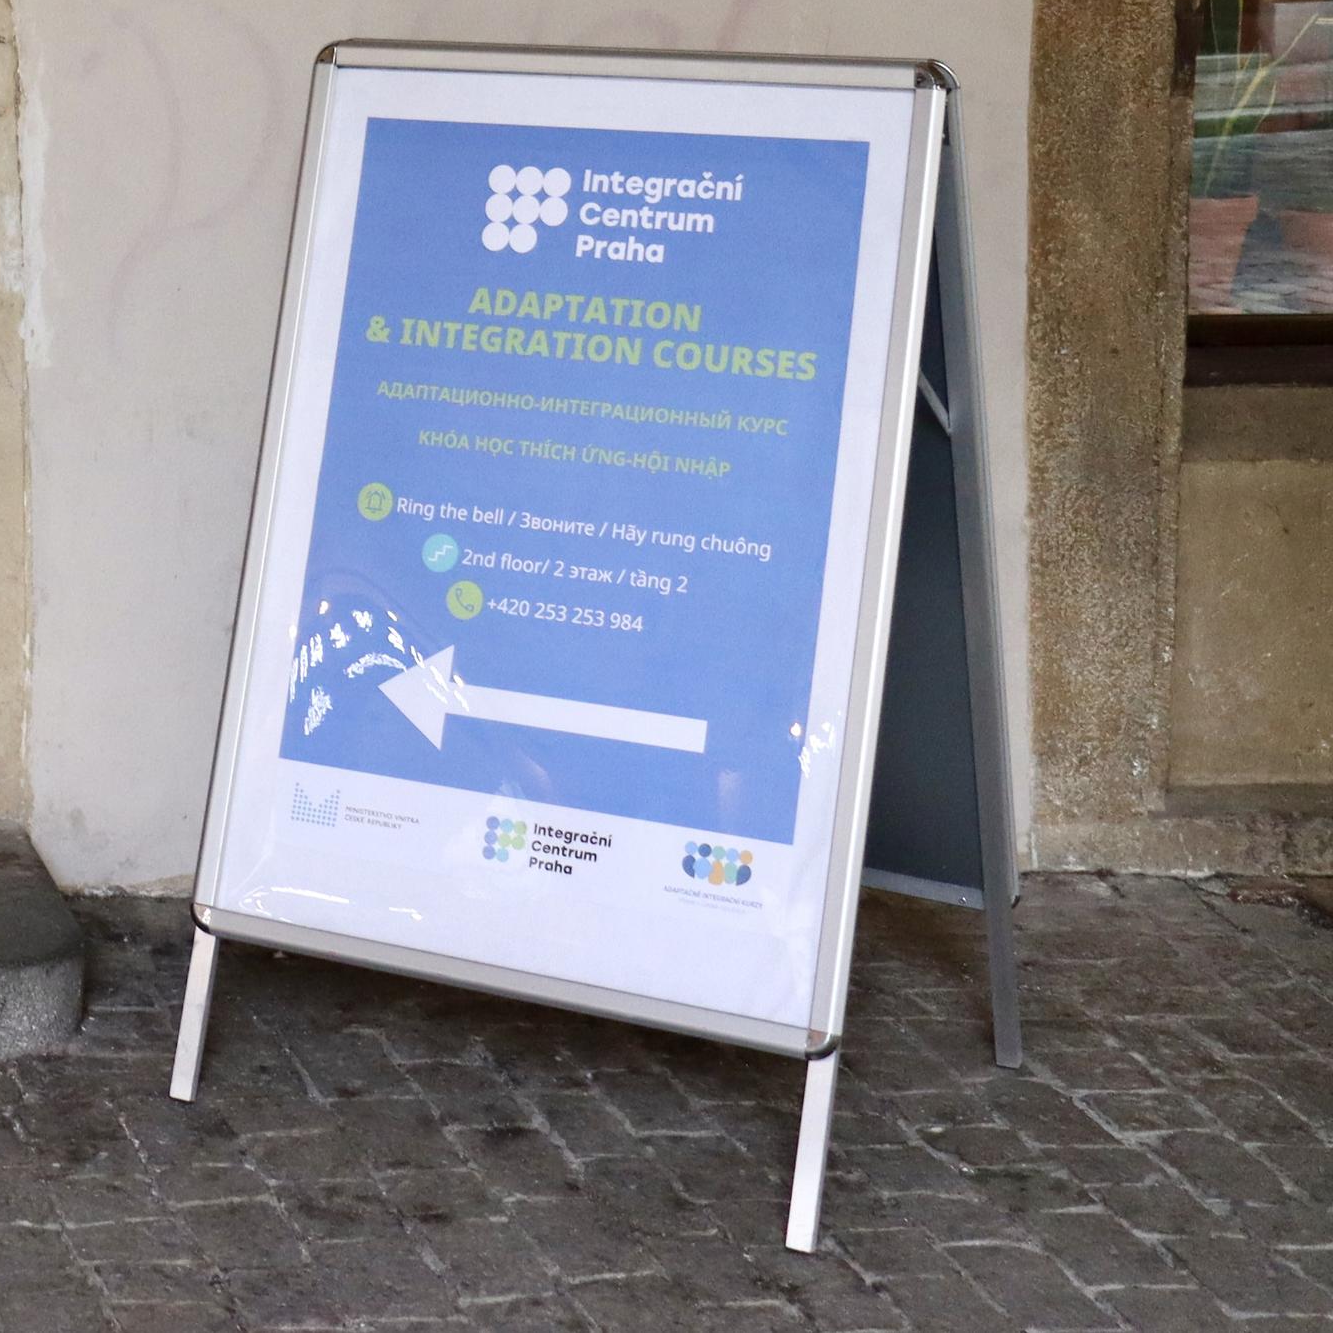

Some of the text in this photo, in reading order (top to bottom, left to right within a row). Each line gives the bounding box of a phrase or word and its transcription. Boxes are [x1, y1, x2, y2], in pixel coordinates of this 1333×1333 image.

[582, 169, 744, 204] Integrační
[579, 202, 715, 233] Centrum
[575, 234, 665, 264] Praha
[468, 286, 702, 332] ADAPTATION
[365, 315, 818, 381] & INTEGRATION COURSES
[376, 380, 789, 436] АДАПТАЦИОННО-ИНТЕГРАЦИОННЫЙ КУРС
[418, 428, 470, 451] KHÓA
[475, 435, 514, 459] HỌC
[519, 437, 577, 463] THÍCH
[675, 455, 731, 479] NHẬP
[396, 497, 772, 562] Ring the bell / Звоните / Hãy rung chuông
[462, 549, 689, 595] 2nd floor/ 2 этаж / tầng 2
[486, 597, 644, 632] +420 253 253 984
[531, 840, 598, 863] Centrum
[533, 823, 613, 848] Integrační
[528, 856, 573, 875] Praha
